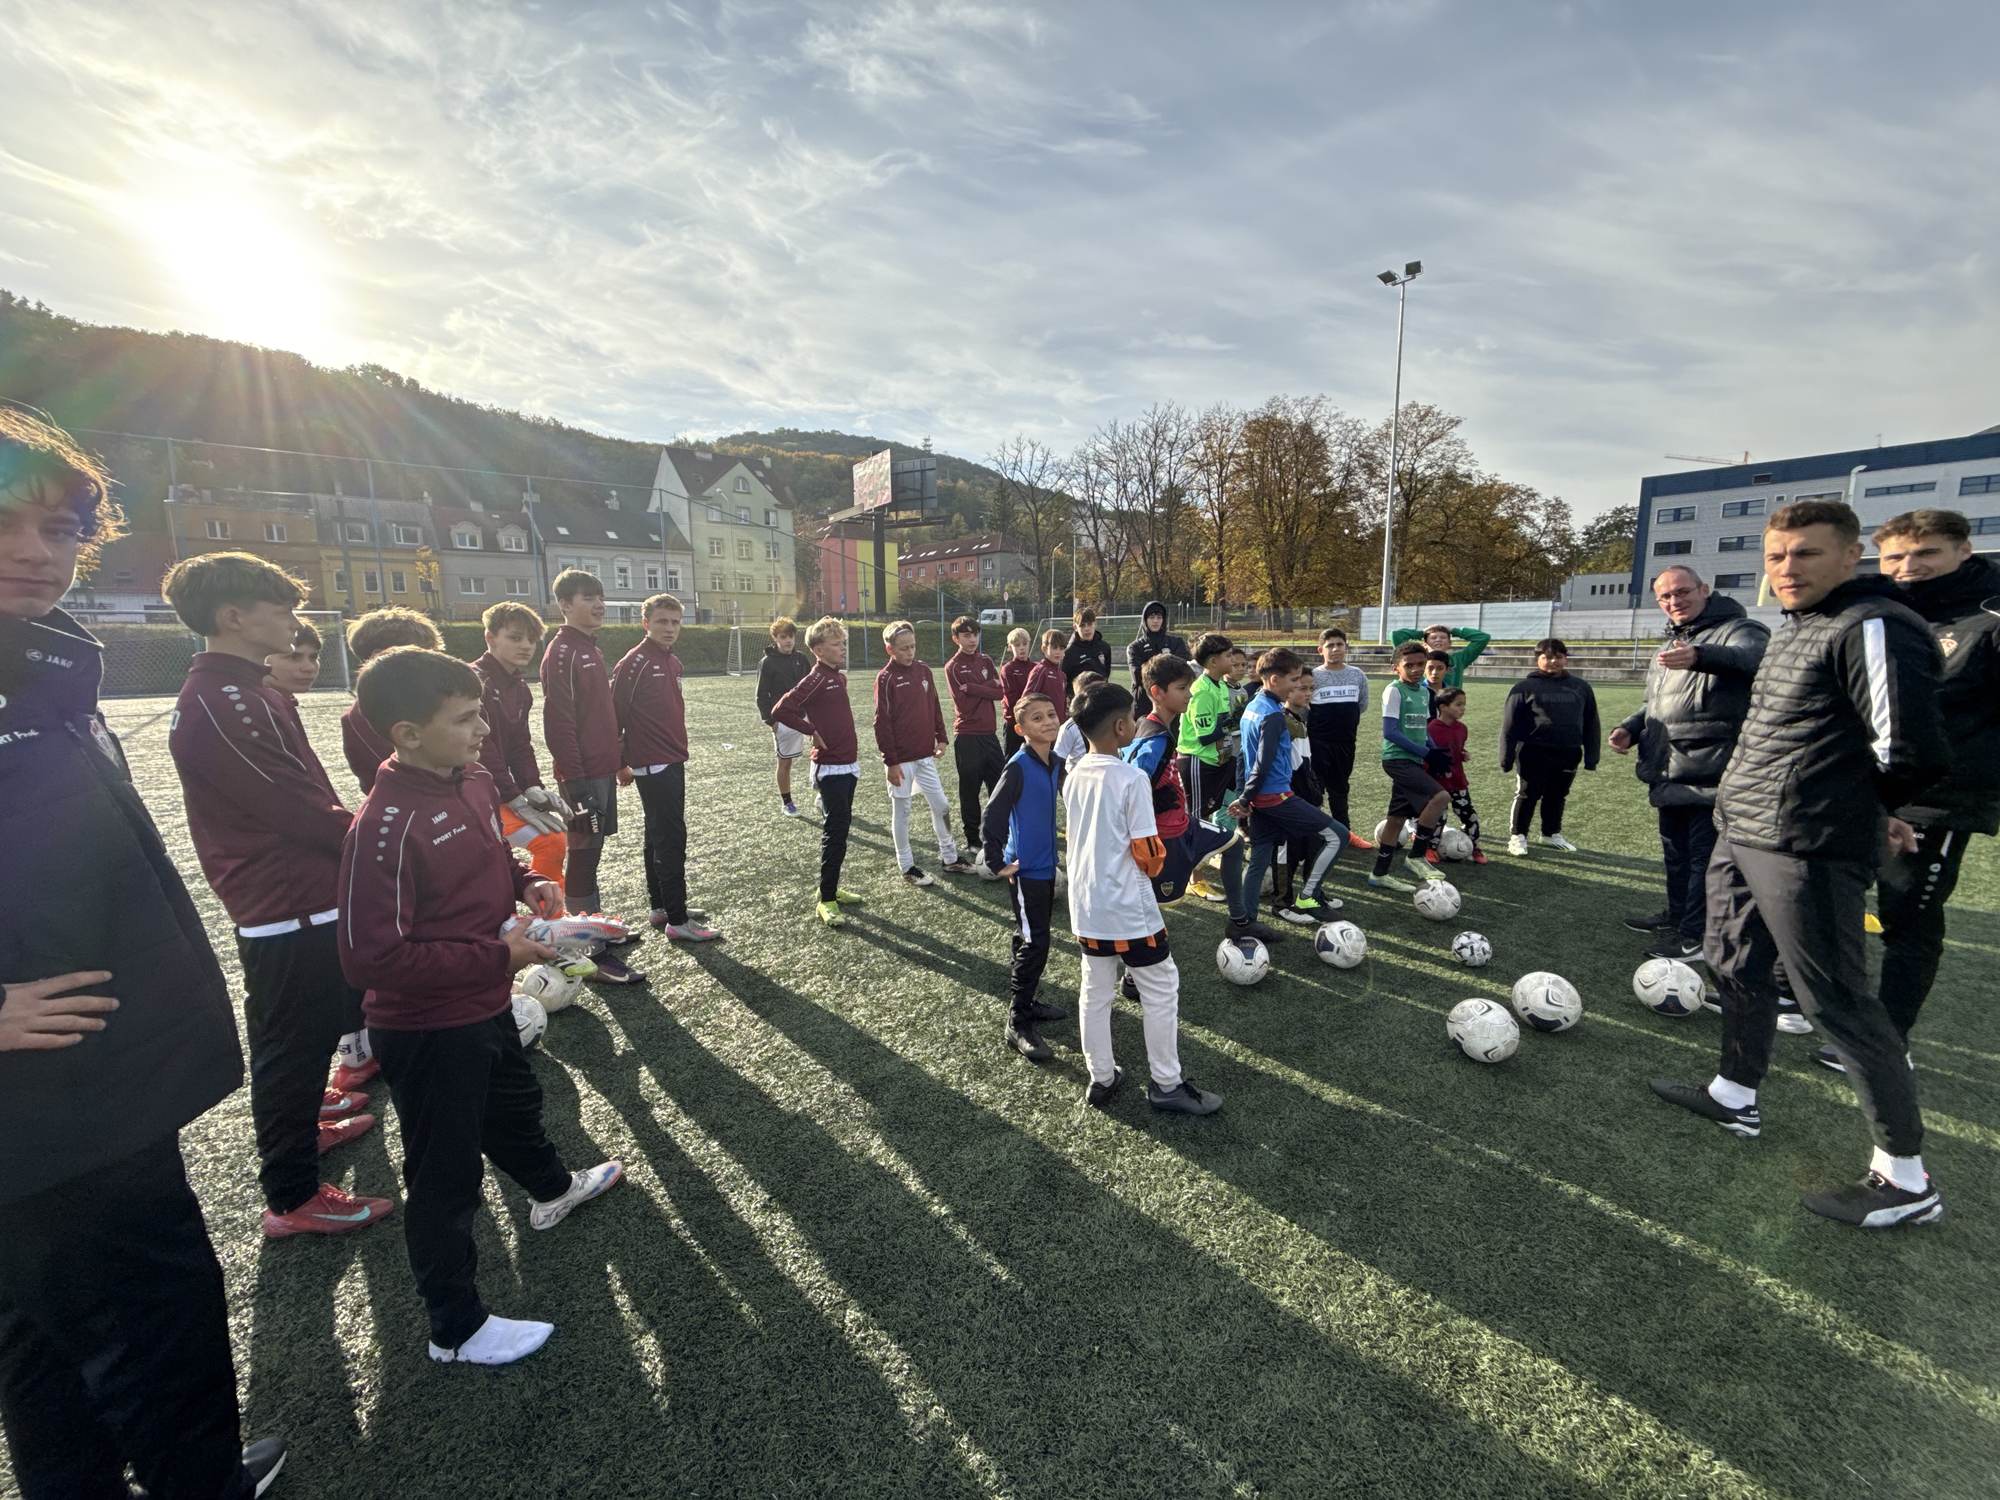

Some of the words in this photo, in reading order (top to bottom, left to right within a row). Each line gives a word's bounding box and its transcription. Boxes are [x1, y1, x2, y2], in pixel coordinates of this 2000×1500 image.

[45, 655, 73, 668] JAKO
[431, 811, 448, 825] JAKO
[590, 814, 600, 833] TITAN
[432, 832, 452, 846] SPORT
